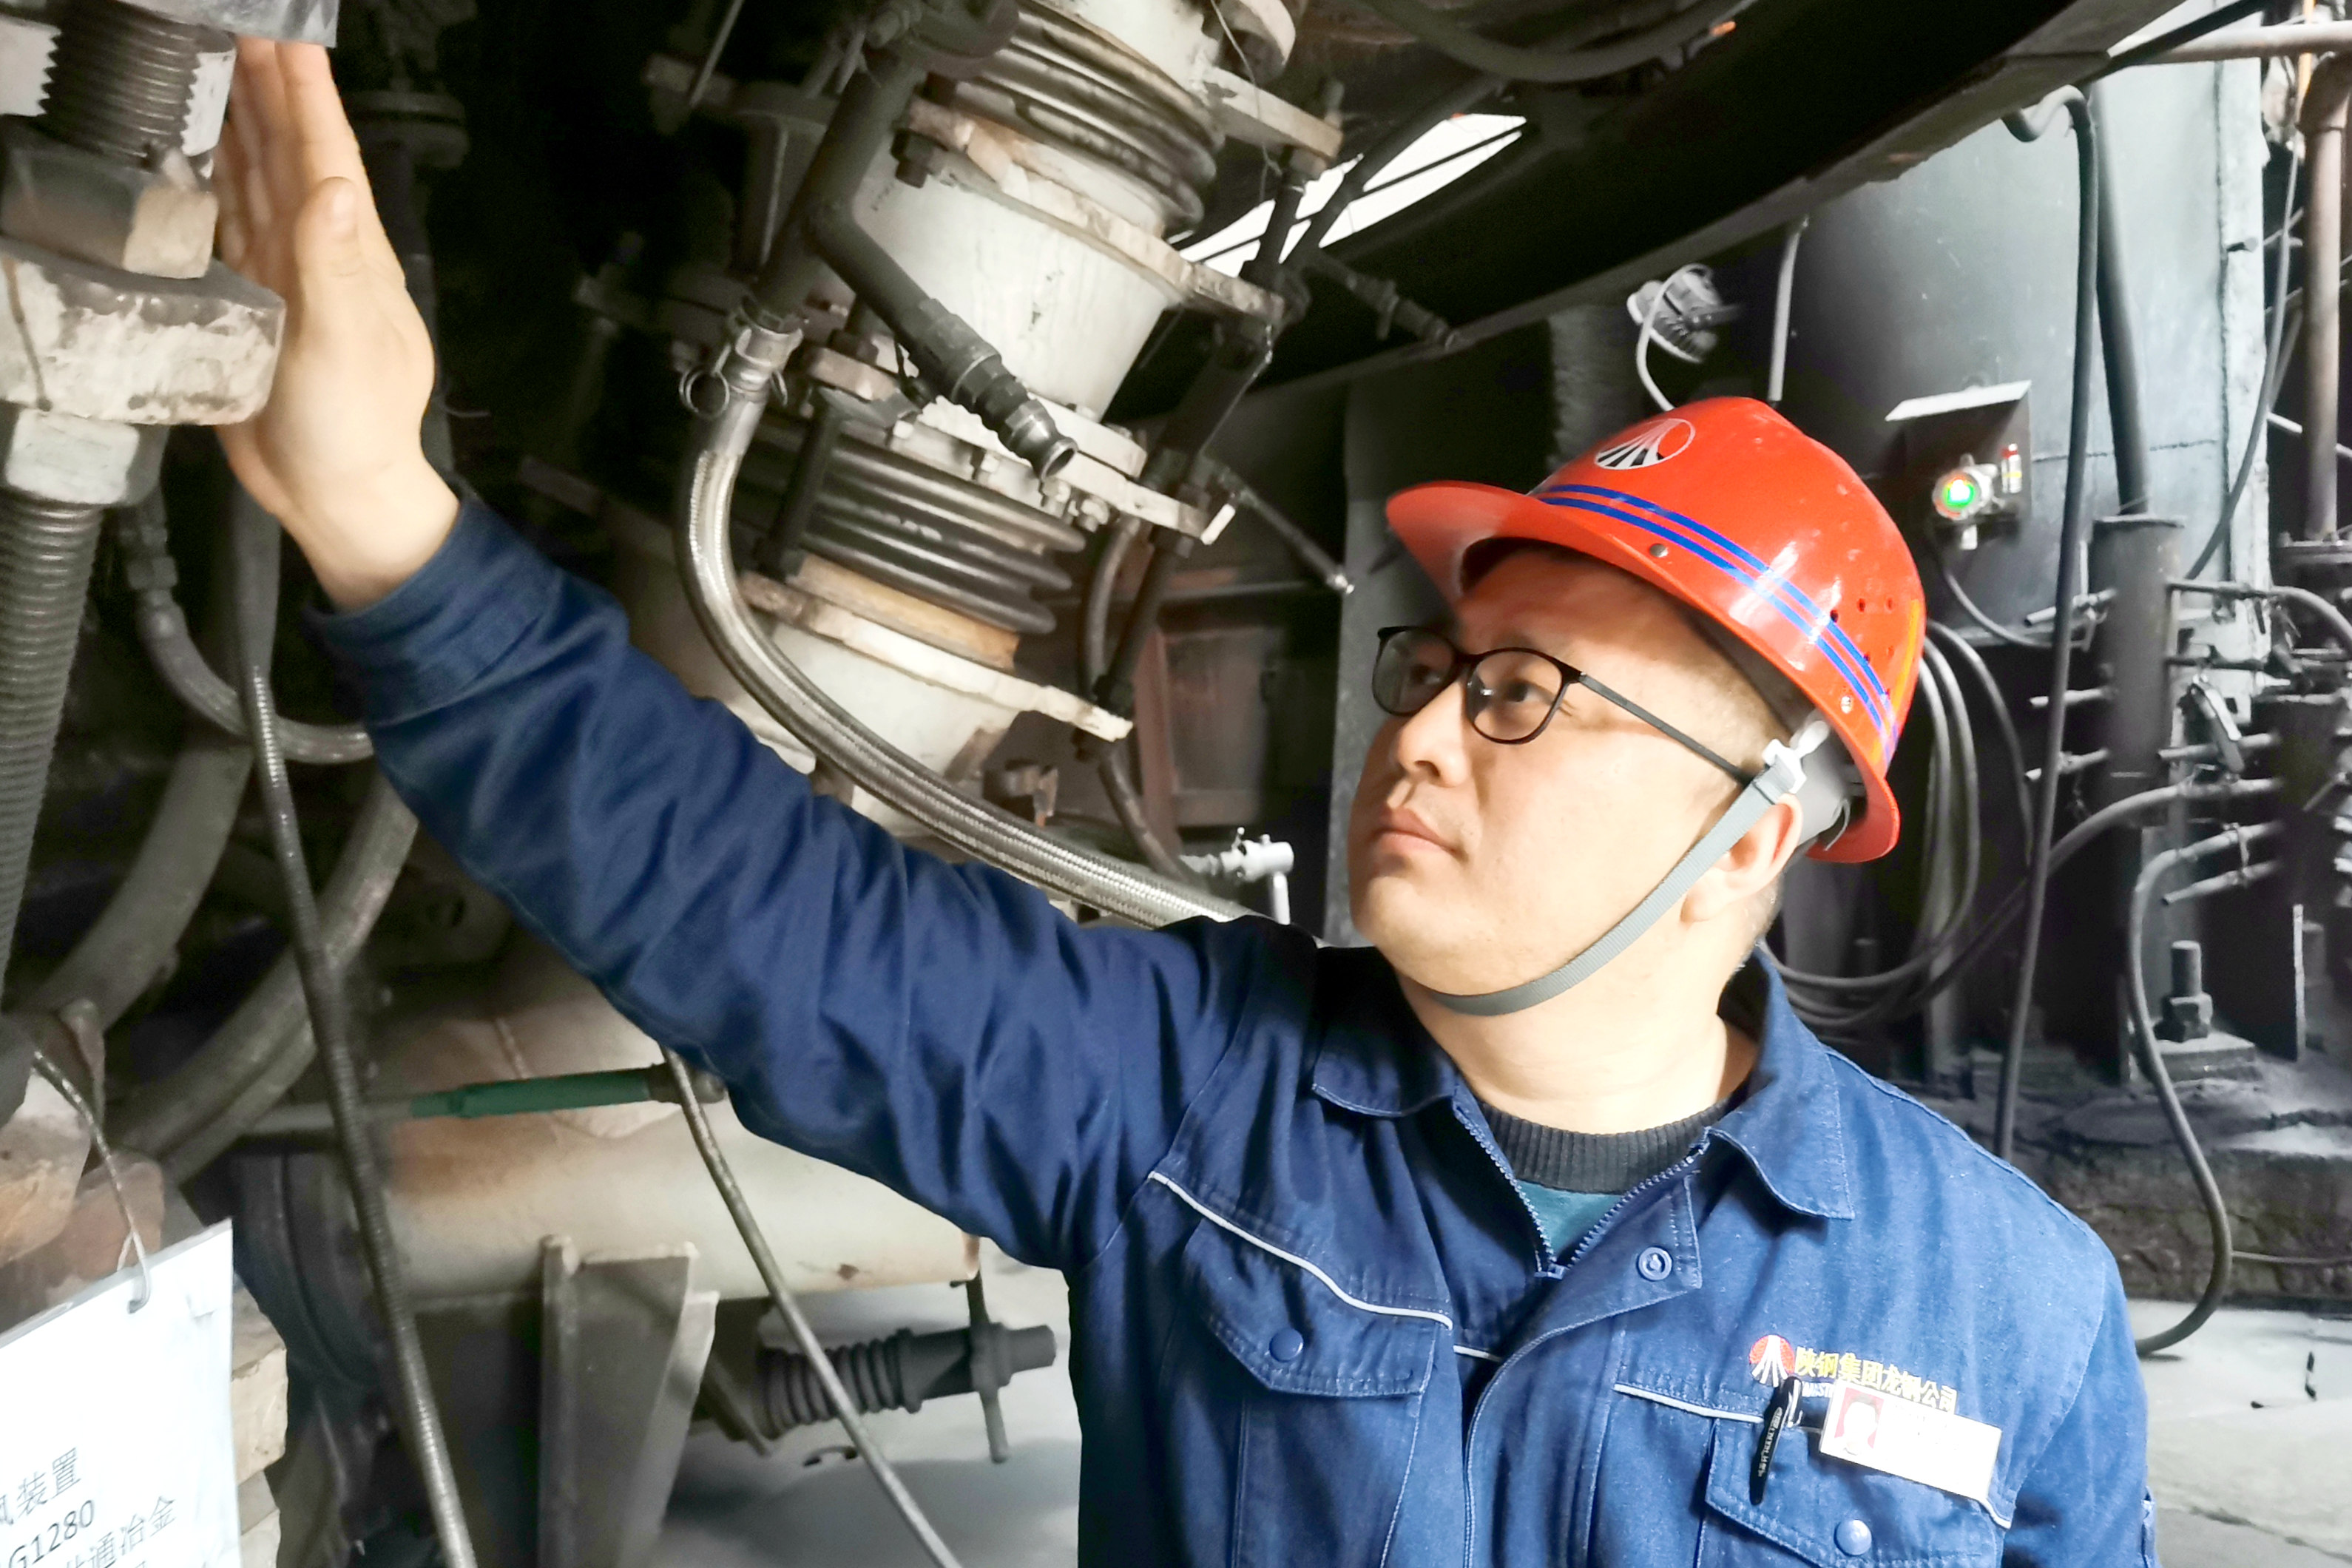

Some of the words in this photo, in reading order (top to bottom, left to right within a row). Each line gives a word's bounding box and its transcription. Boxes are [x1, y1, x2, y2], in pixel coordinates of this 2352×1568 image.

[1794, 1345, 1958, 1413] 陕钢集团龙钢公司
[9, 1499, 94, 1568] G1280
